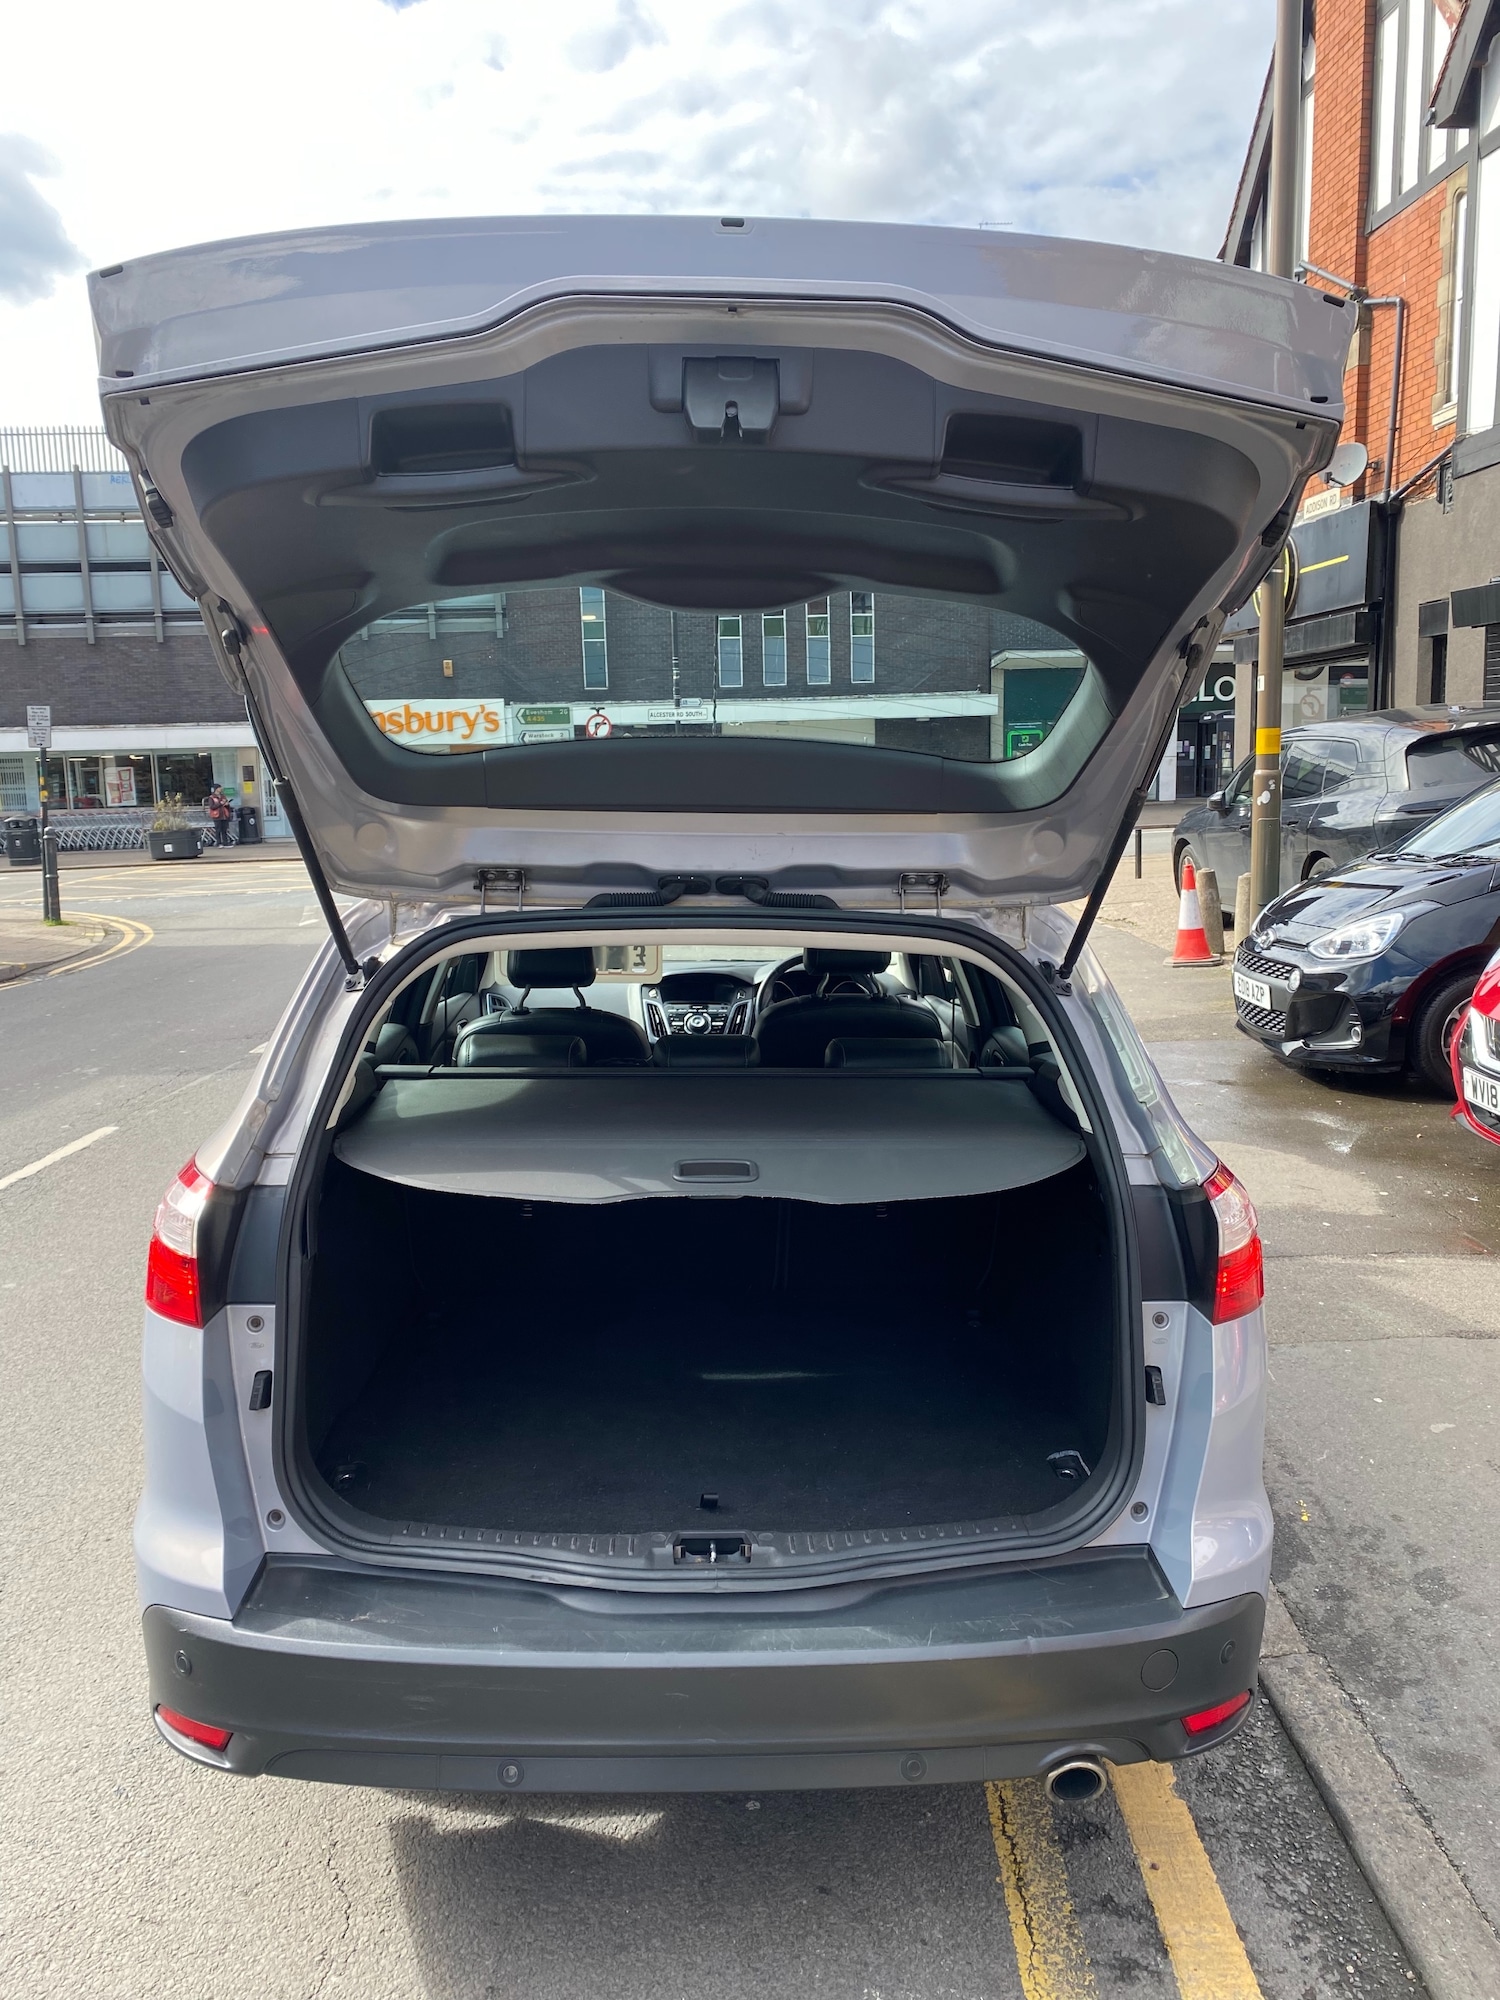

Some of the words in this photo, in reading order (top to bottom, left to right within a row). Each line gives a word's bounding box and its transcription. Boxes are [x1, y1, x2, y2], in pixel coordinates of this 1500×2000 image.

[1306, 497, 1328, 514] ADDISON
[1329, 493, 1337, 507] RD
[1192, 676, 1236, 701] LO
[1251, 983, 1265, 1003] AZP
